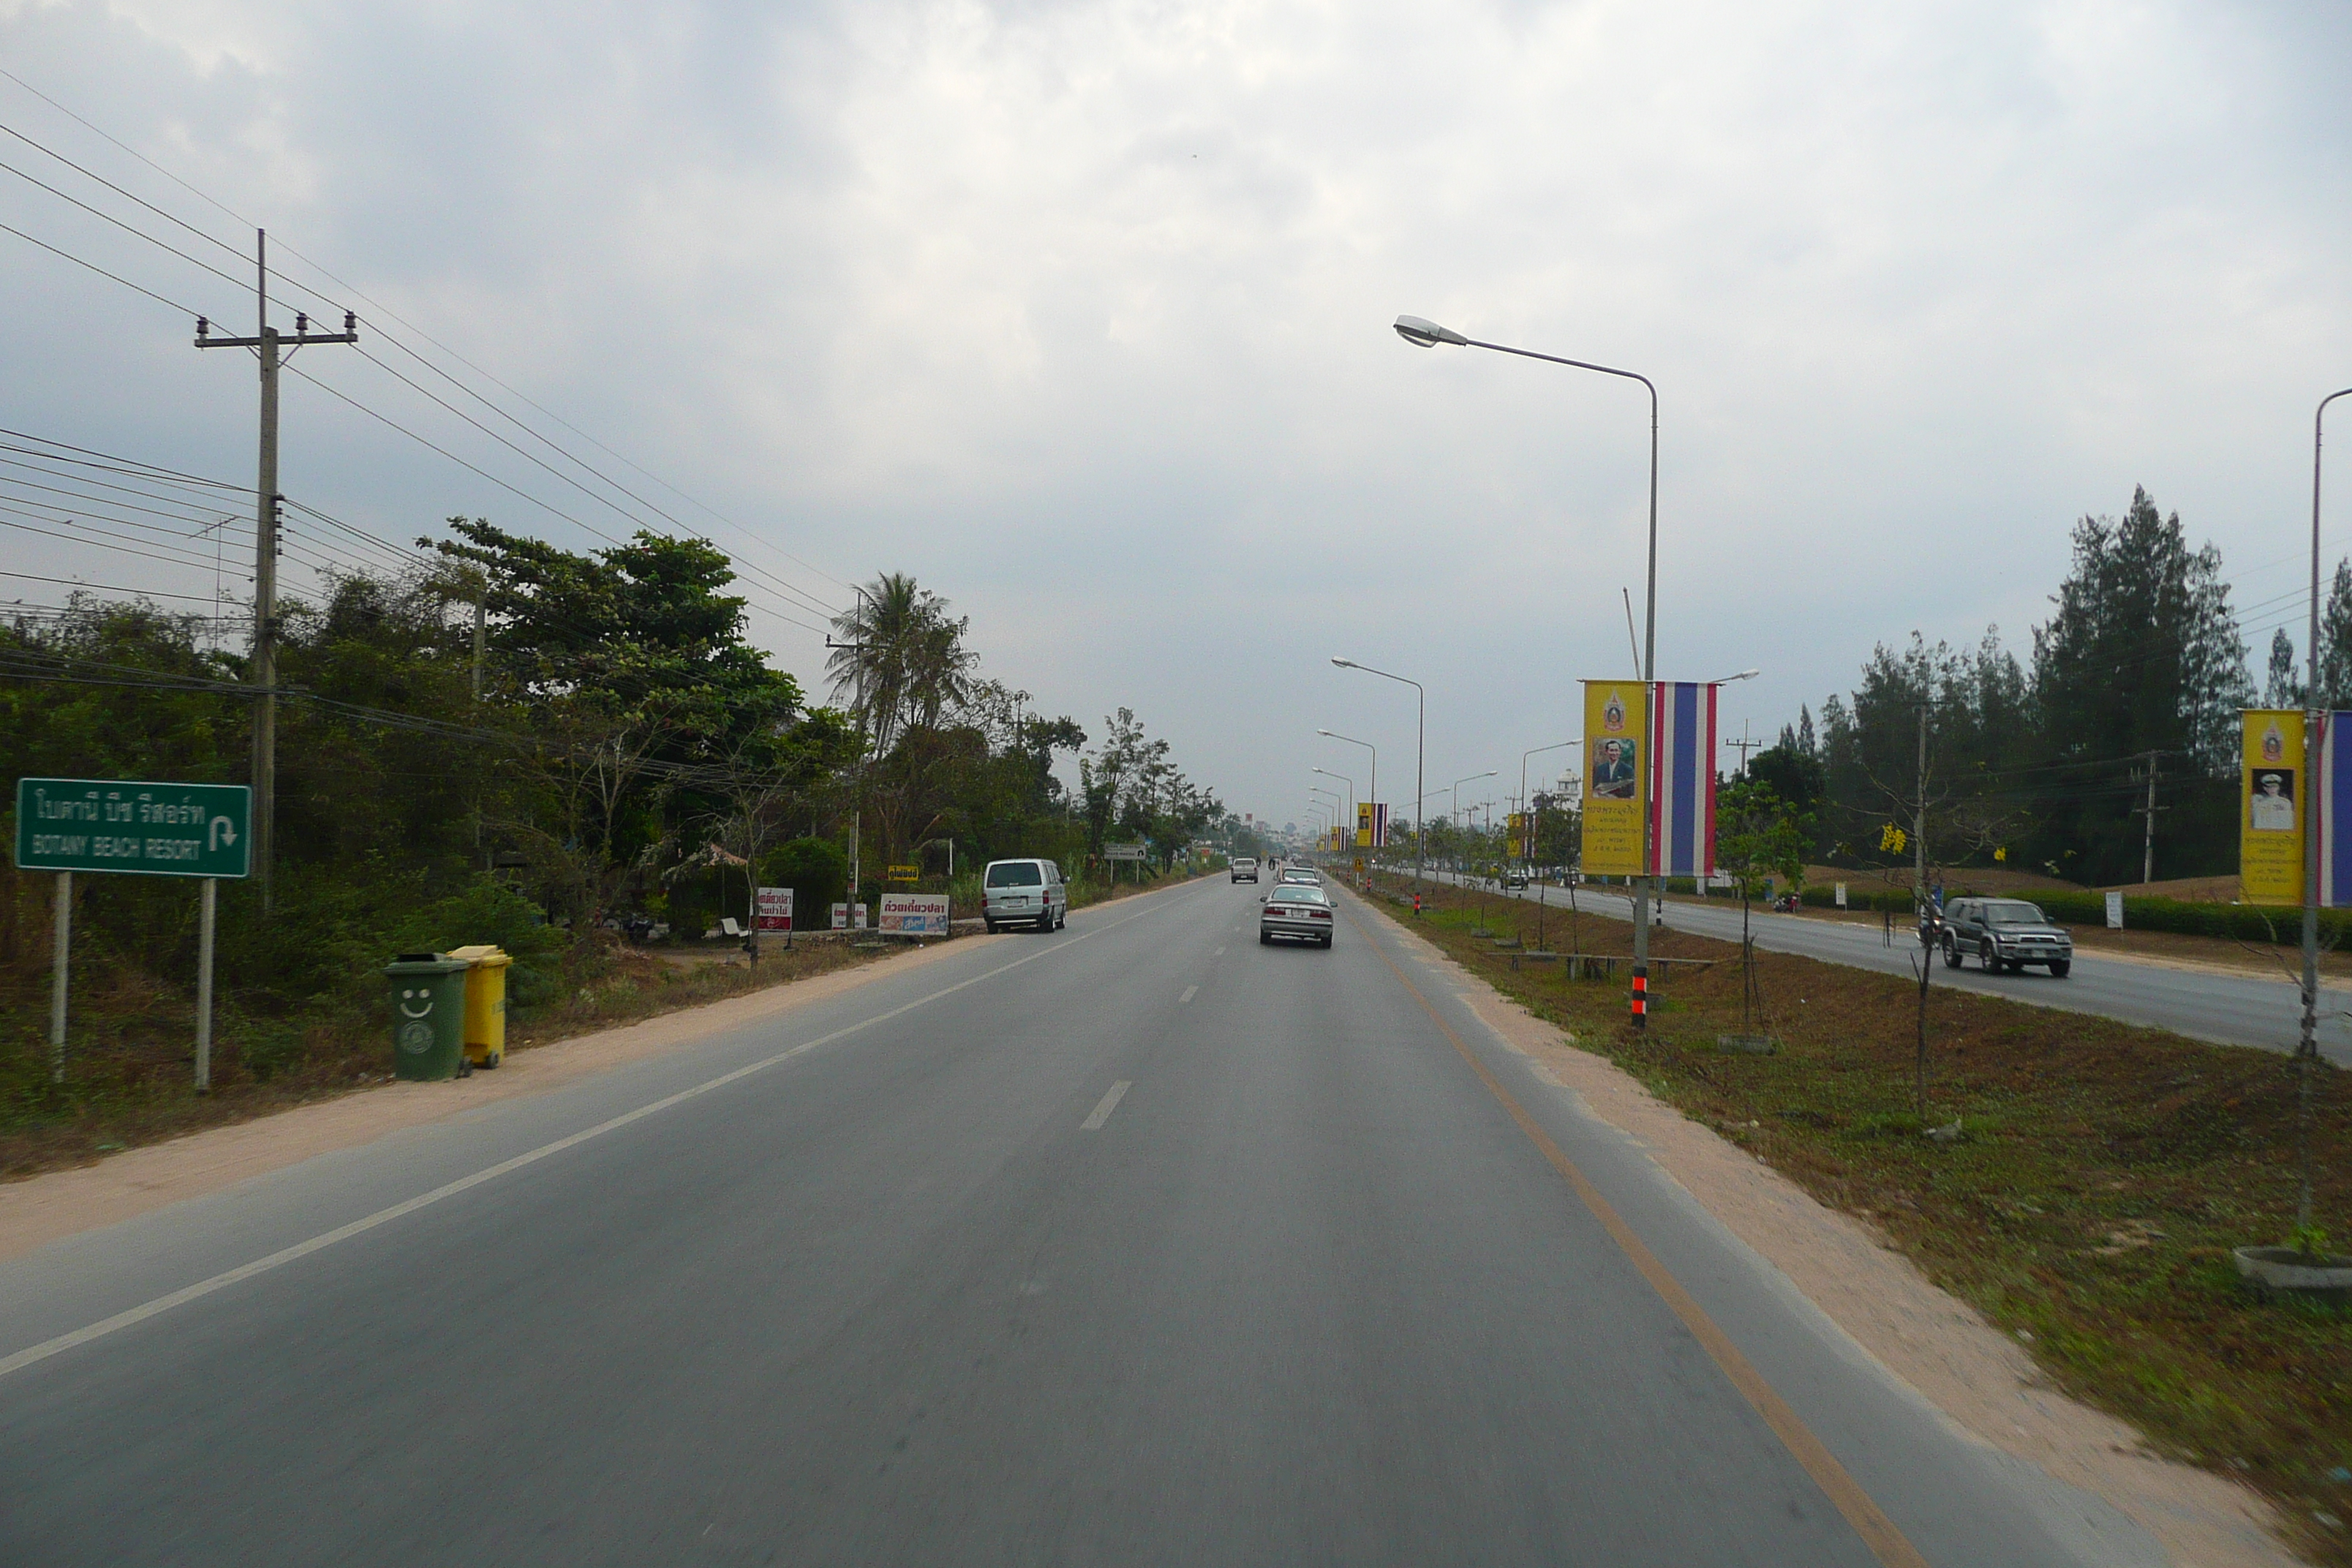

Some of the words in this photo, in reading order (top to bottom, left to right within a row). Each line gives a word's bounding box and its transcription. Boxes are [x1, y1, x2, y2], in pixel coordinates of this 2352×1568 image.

[34, 788, 99, 821] โบตานี
[104, 791, 134, 822] บีช
[137, 792, 206, 824] รีสอร์ท
[32, 834, 88, 856] BOTANY
[93, 836, 140, 858] BEACH
[146, 837, 202, 861] RESORT
